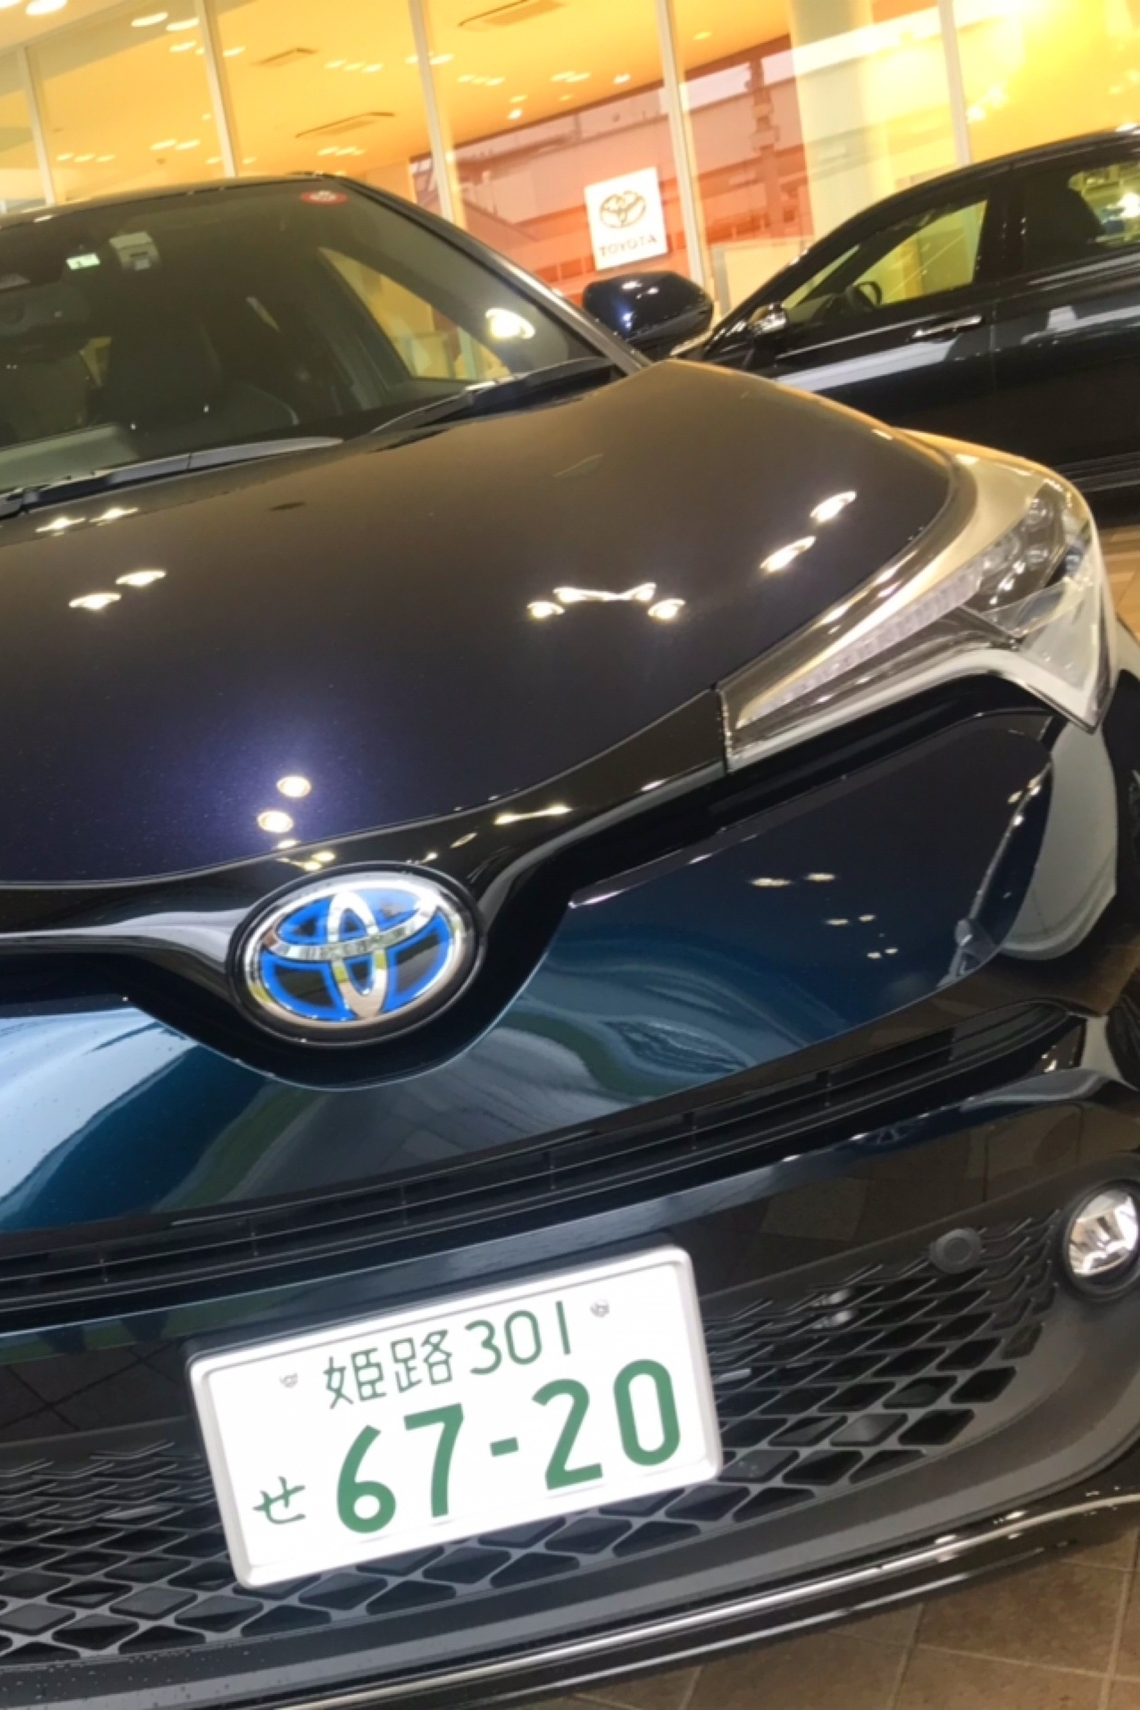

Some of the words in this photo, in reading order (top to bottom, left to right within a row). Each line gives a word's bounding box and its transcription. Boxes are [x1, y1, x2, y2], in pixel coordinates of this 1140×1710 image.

[599, 234, 657, 257] TOYOTA
[323, 1330, 453, 1409] 姫路
[465, 1301, 571, 1375] 301
[253, 1476, 306, 1524] せ
[336, 1359, 681, 1534] 67-20
